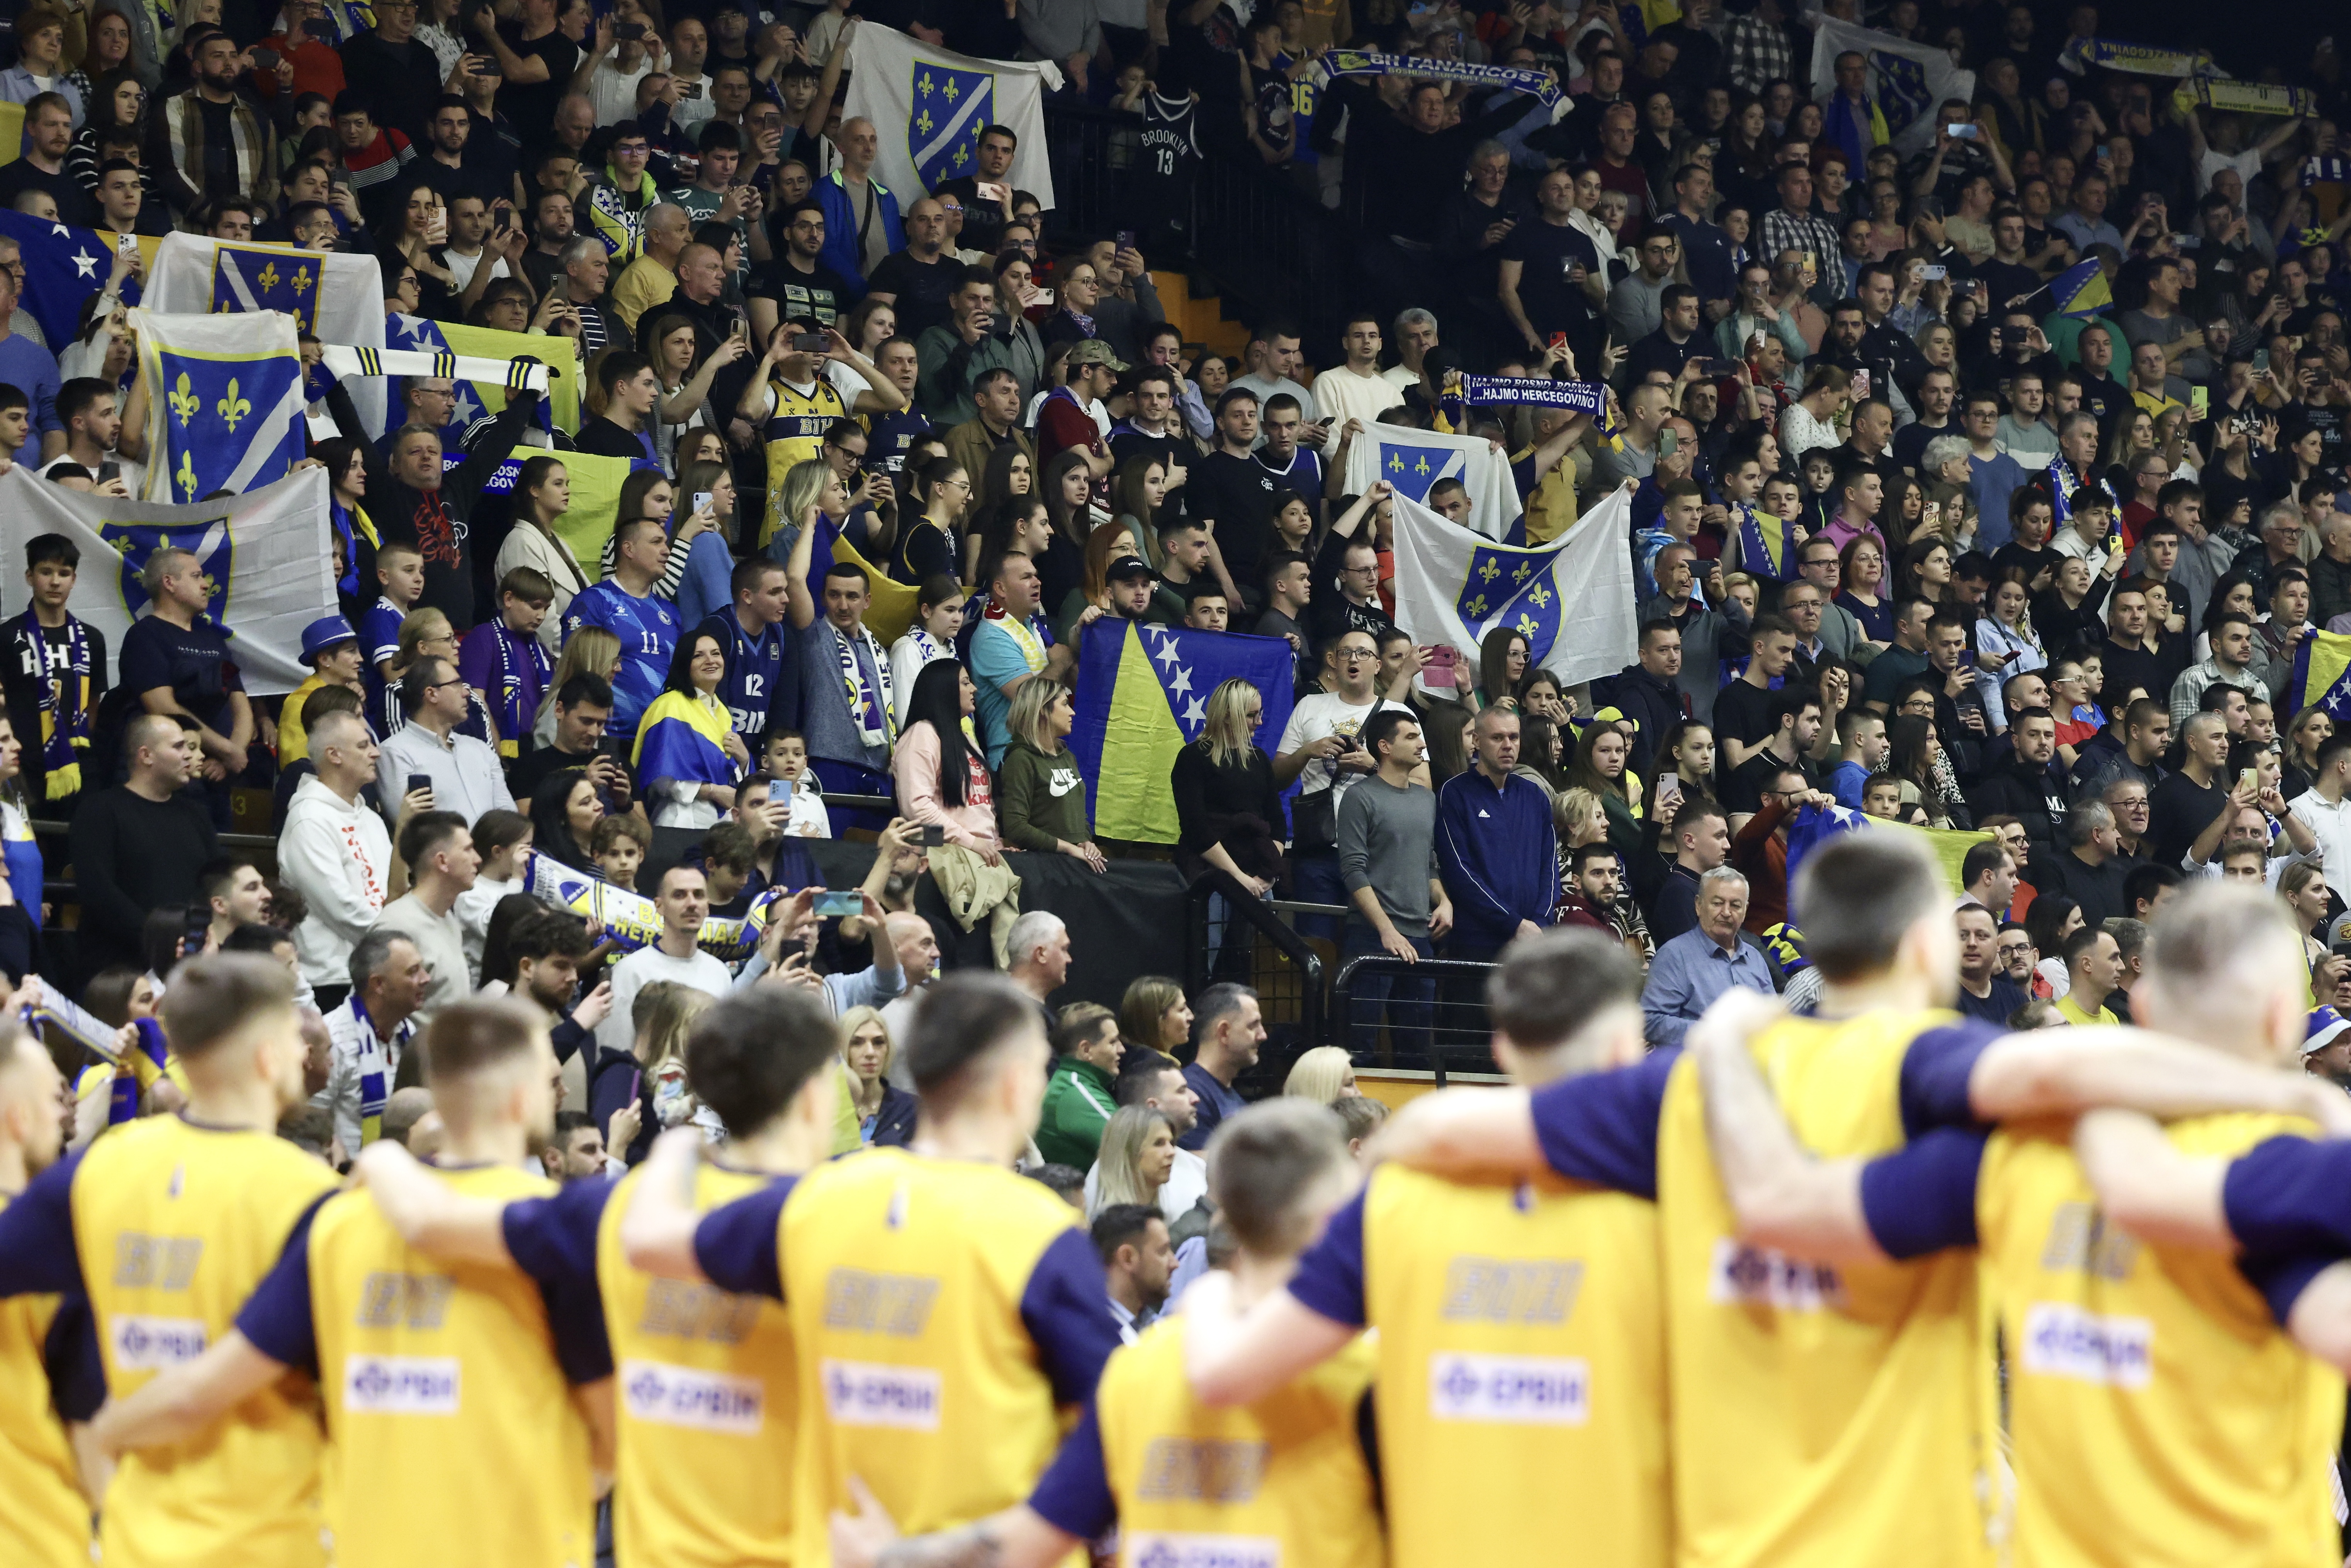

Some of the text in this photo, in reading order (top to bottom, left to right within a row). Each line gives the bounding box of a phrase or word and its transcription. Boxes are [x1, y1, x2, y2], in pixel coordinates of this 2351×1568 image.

[1370, 54, 1533, 82] BH FANATICOS
[1141, 129, 1188, 156] BROOKLYN
[1157, 148, 1173, 175] 13
[1472, 377, 1511, 387] HAJMO
[1522, 389, 1595, 409] HERCEGOVINO
[800, 418, 833, 435] BIH
[641, 631, 659, 654] 11
[746, 673, 764, 697] 12
[1050, 768, 1076, 783] NIKE
